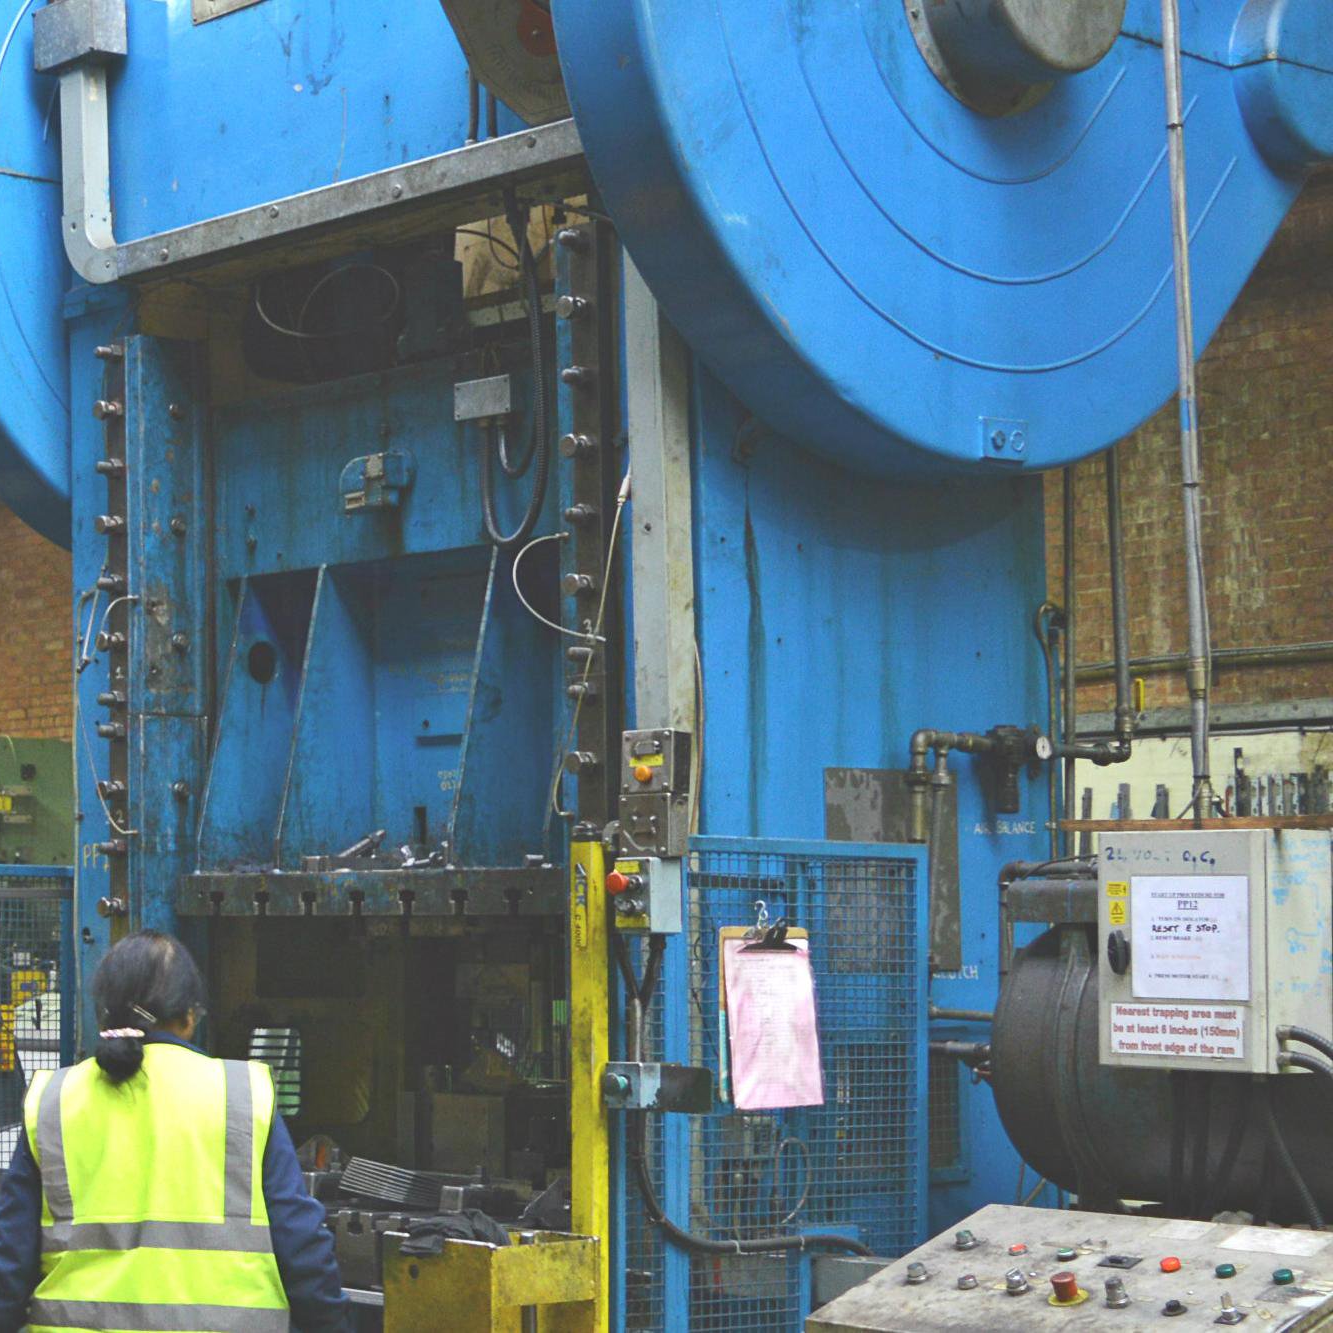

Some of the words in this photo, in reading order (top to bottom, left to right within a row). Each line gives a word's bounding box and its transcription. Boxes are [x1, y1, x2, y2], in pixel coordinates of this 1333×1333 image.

[1177, 900, 1198, 909] PP12
[1152, 924, 1179, 933] RESET
[1186, 924, 1192, 932] E
[1116, 1006, 1150, 1016] Nearest
[1153, 1007, 1189, 1020] trapping
[1191, 1010, 1211, 1019] area
[1214, 1010, 1237, 1019] must
[1113, 1023, 1124, 1032] be
[1126, 1024, 1135, 1033] at
[1137, 1024, 1159, 1034] least
[1161, 1025, 1167, 1034] 6
[1169, 1025, 1198, 1035] inches
[1200, 1026, 1240, 1040] (150mm)
[1118, 1040, 1138, 1049] from
[1141, 1040, 1162, 1051] front
[1164, 1042, 1186, 1054] edge
[1188, 1043, 1197, 1052] of
[1200, 1043, 1214, 1053] the
[1217, 1046, 1236, 1055] ram
